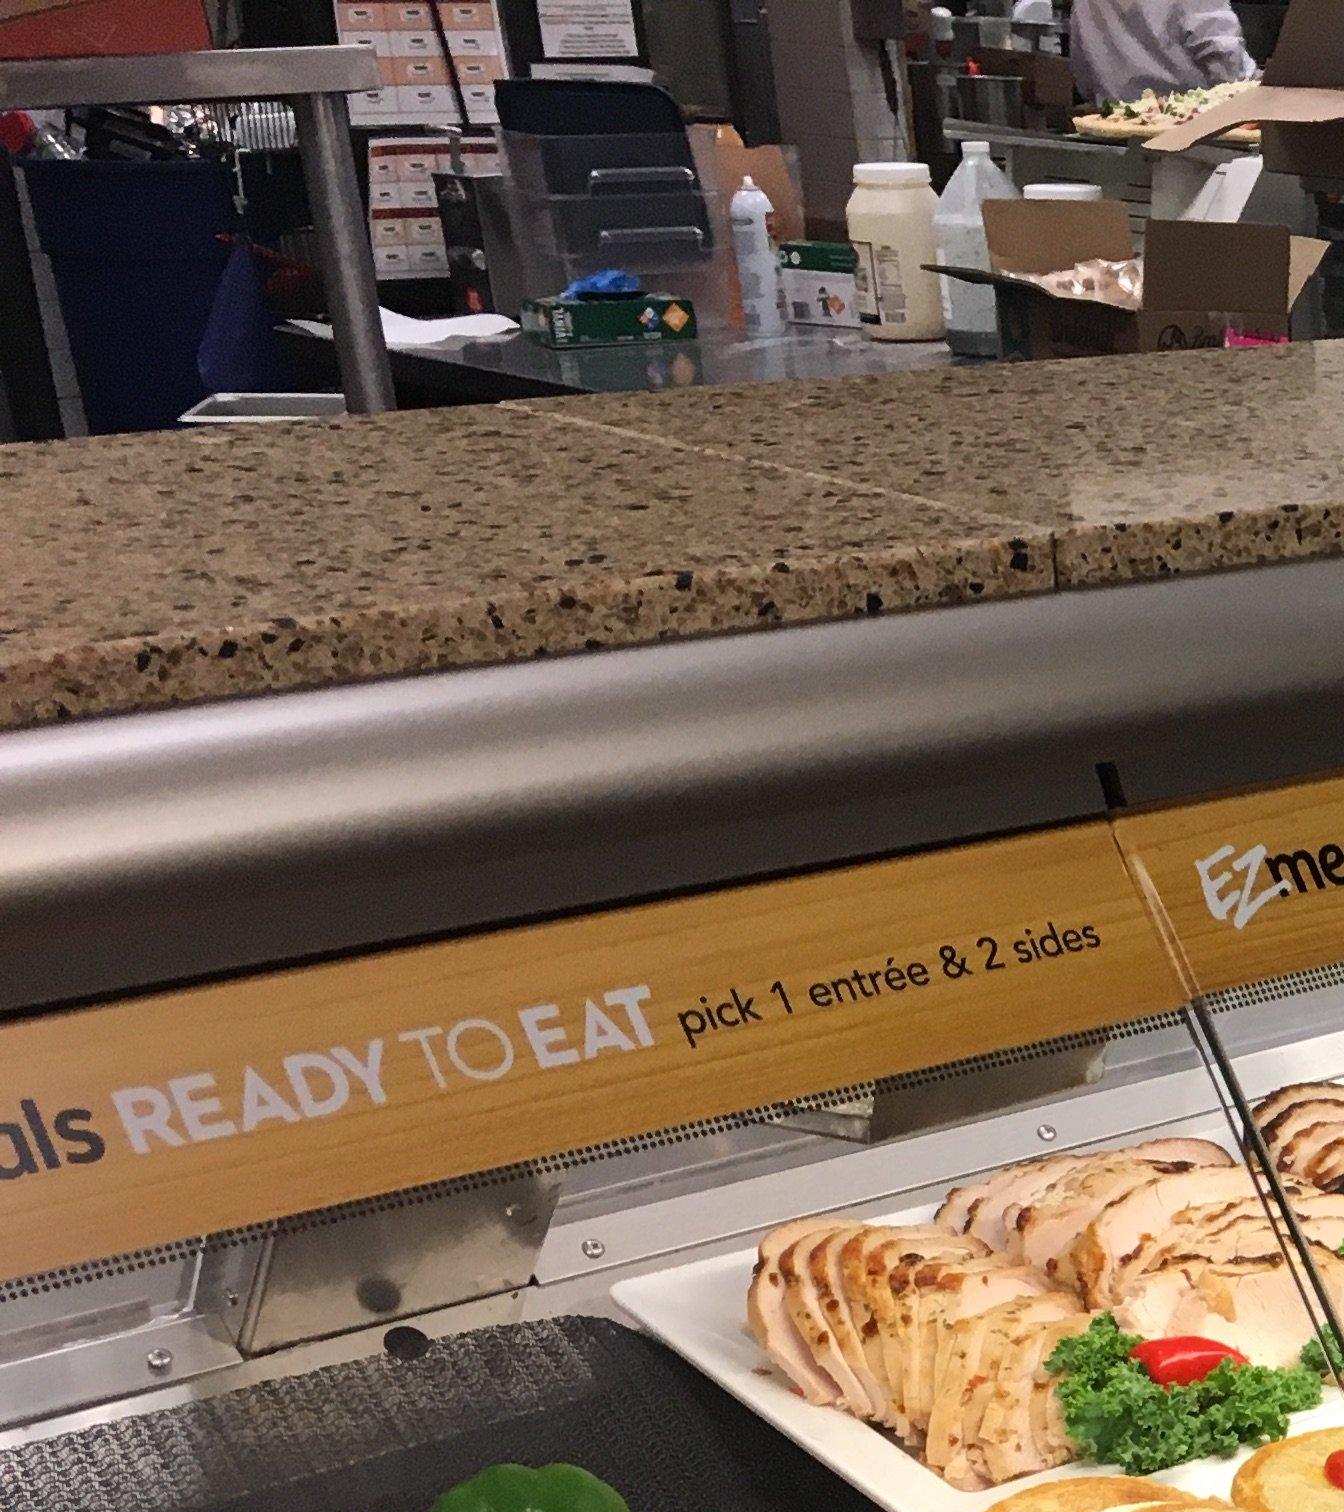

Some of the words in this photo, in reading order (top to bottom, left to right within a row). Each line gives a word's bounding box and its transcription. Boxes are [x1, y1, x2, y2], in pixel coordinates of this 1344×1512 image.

[110, 1038, 385, 1154] READY
[398, 1019, 514, 1089] TO
[520, 984, 653, 1069] EAT
[677, 988, 760, 1048] pick
[770, 981, 793, 1014] 1
[809, 957, 928, 1007] entrée
[940, 945, 970, 979] &
[976, 937, 1006, 971] 2
[1013, 922, 1101, 963] sides
